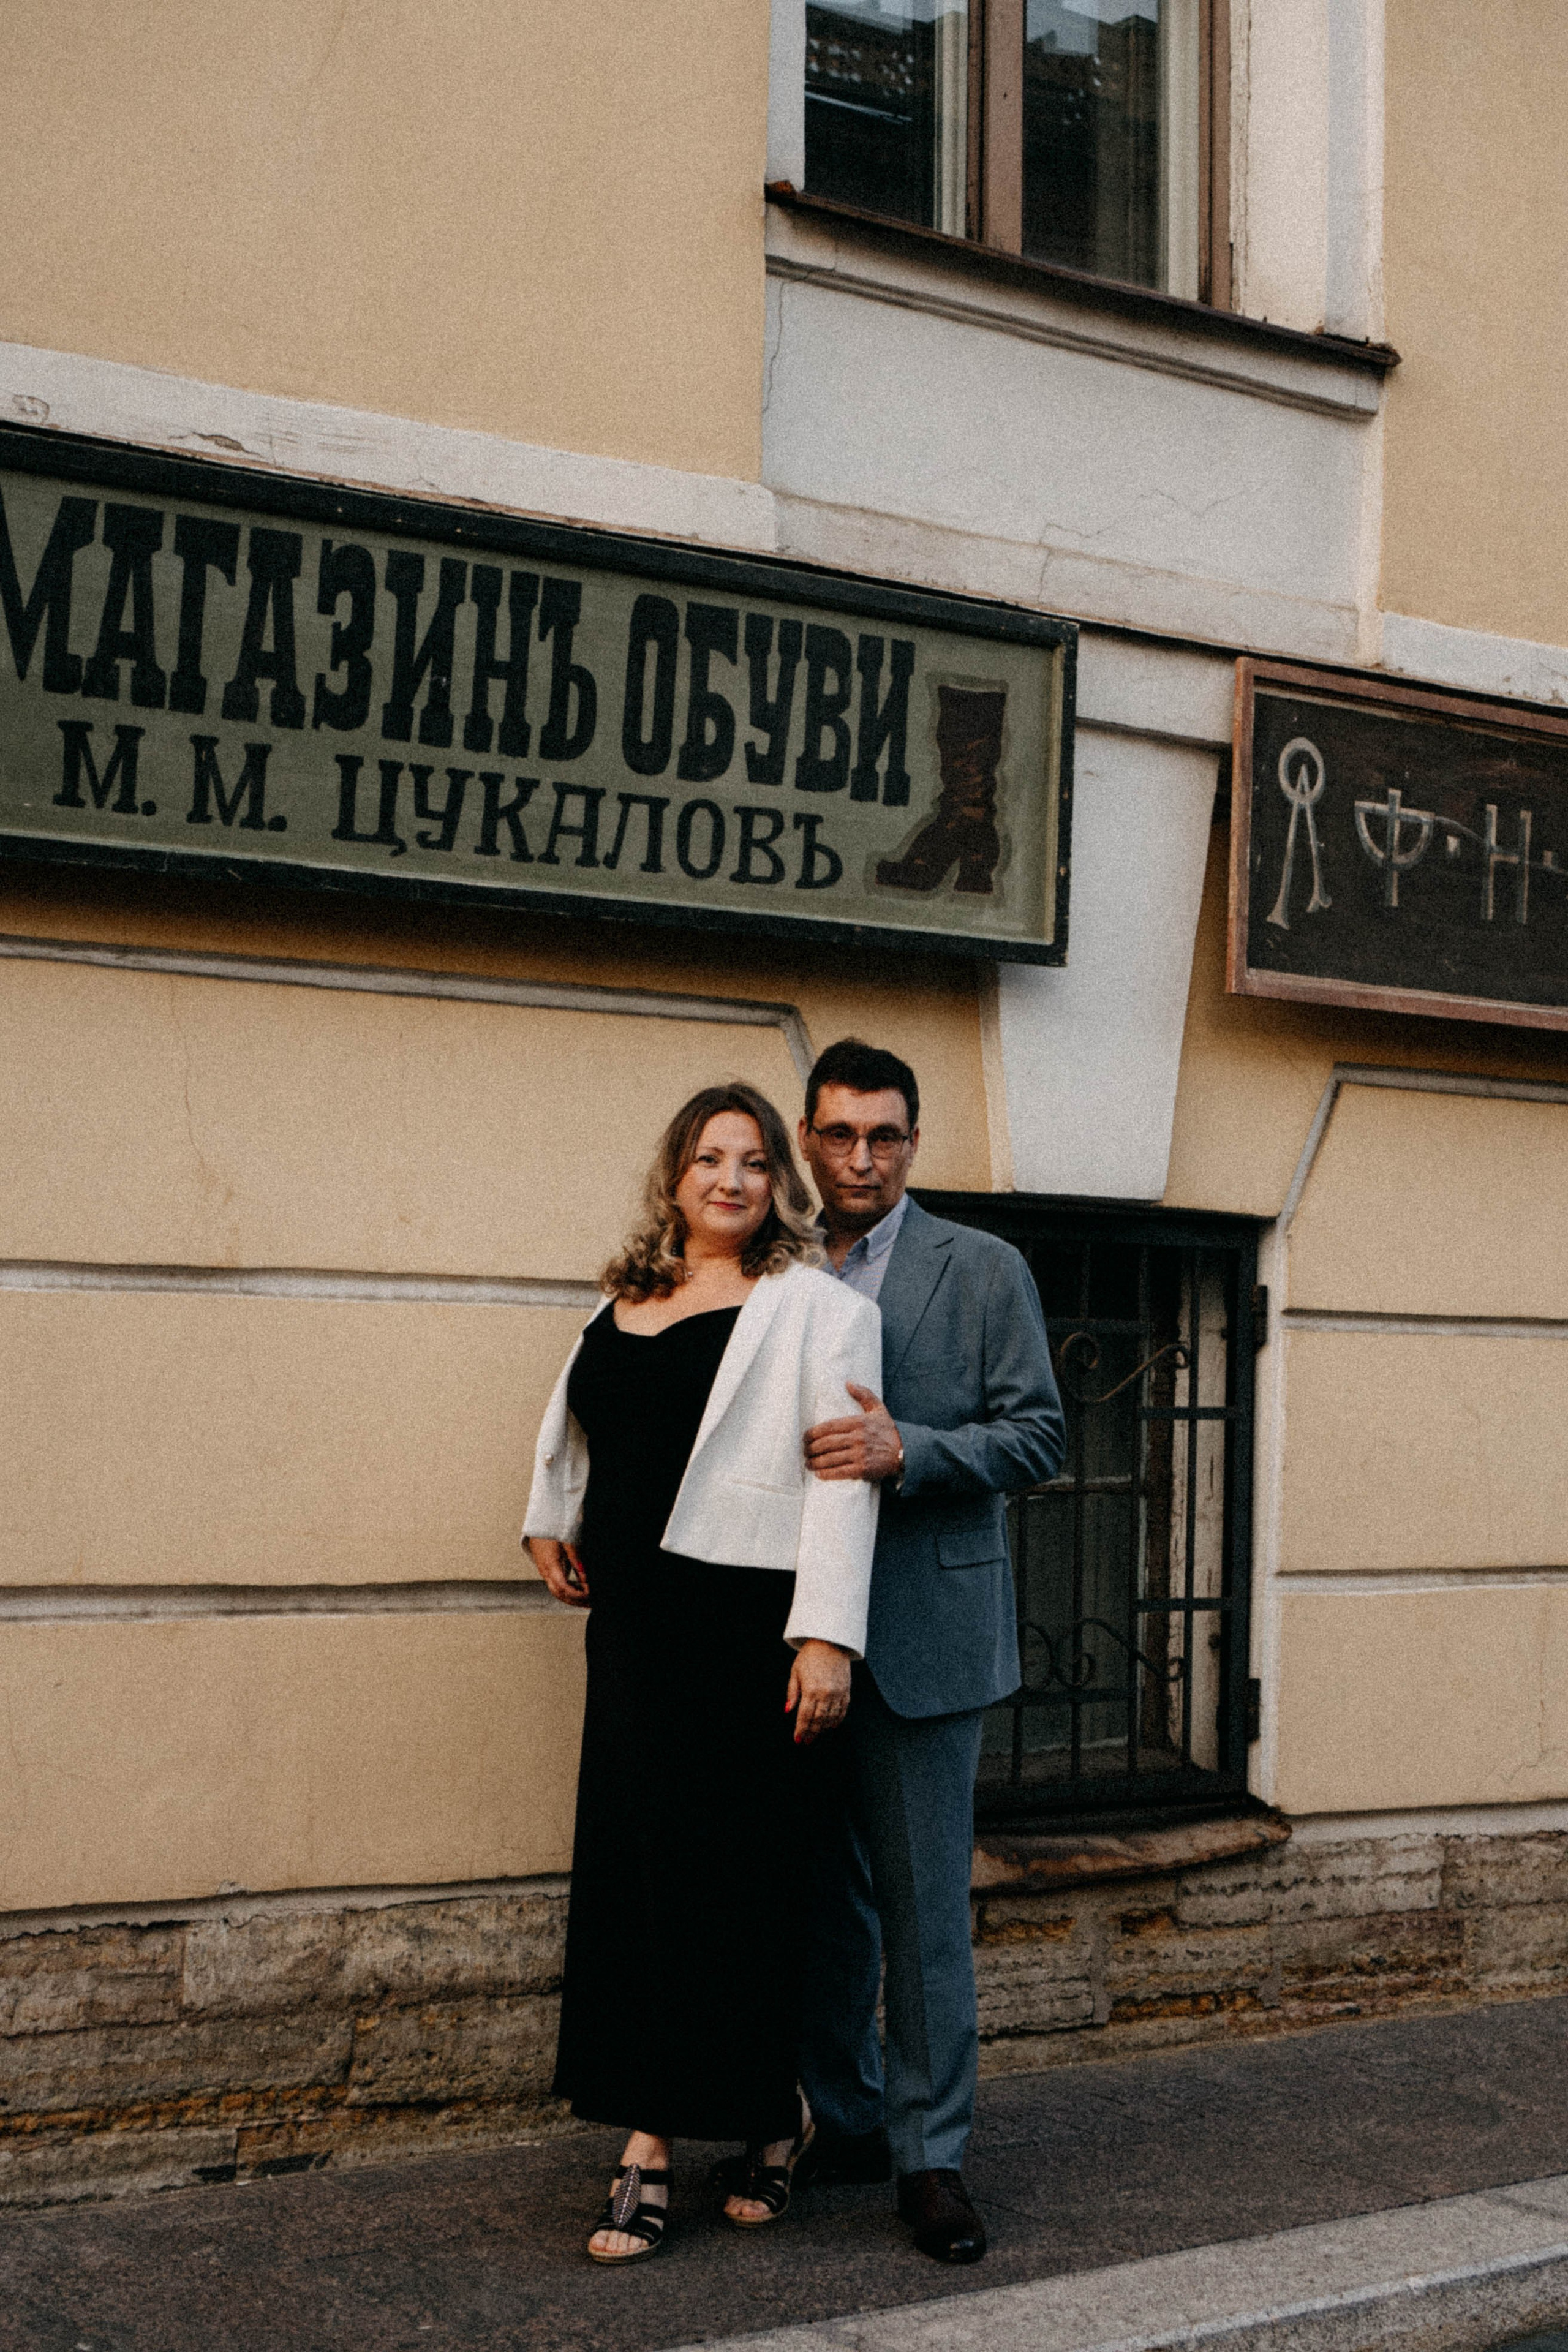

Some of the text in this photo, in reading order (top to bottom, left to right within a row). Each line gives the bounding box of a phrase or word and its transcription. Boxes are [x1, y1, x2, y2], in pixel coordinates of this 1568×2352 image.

[621, 593, 916, 807] ОБУВИ
[53, 720, 843, 890] М. М. ЦУКАЛОВЪ
